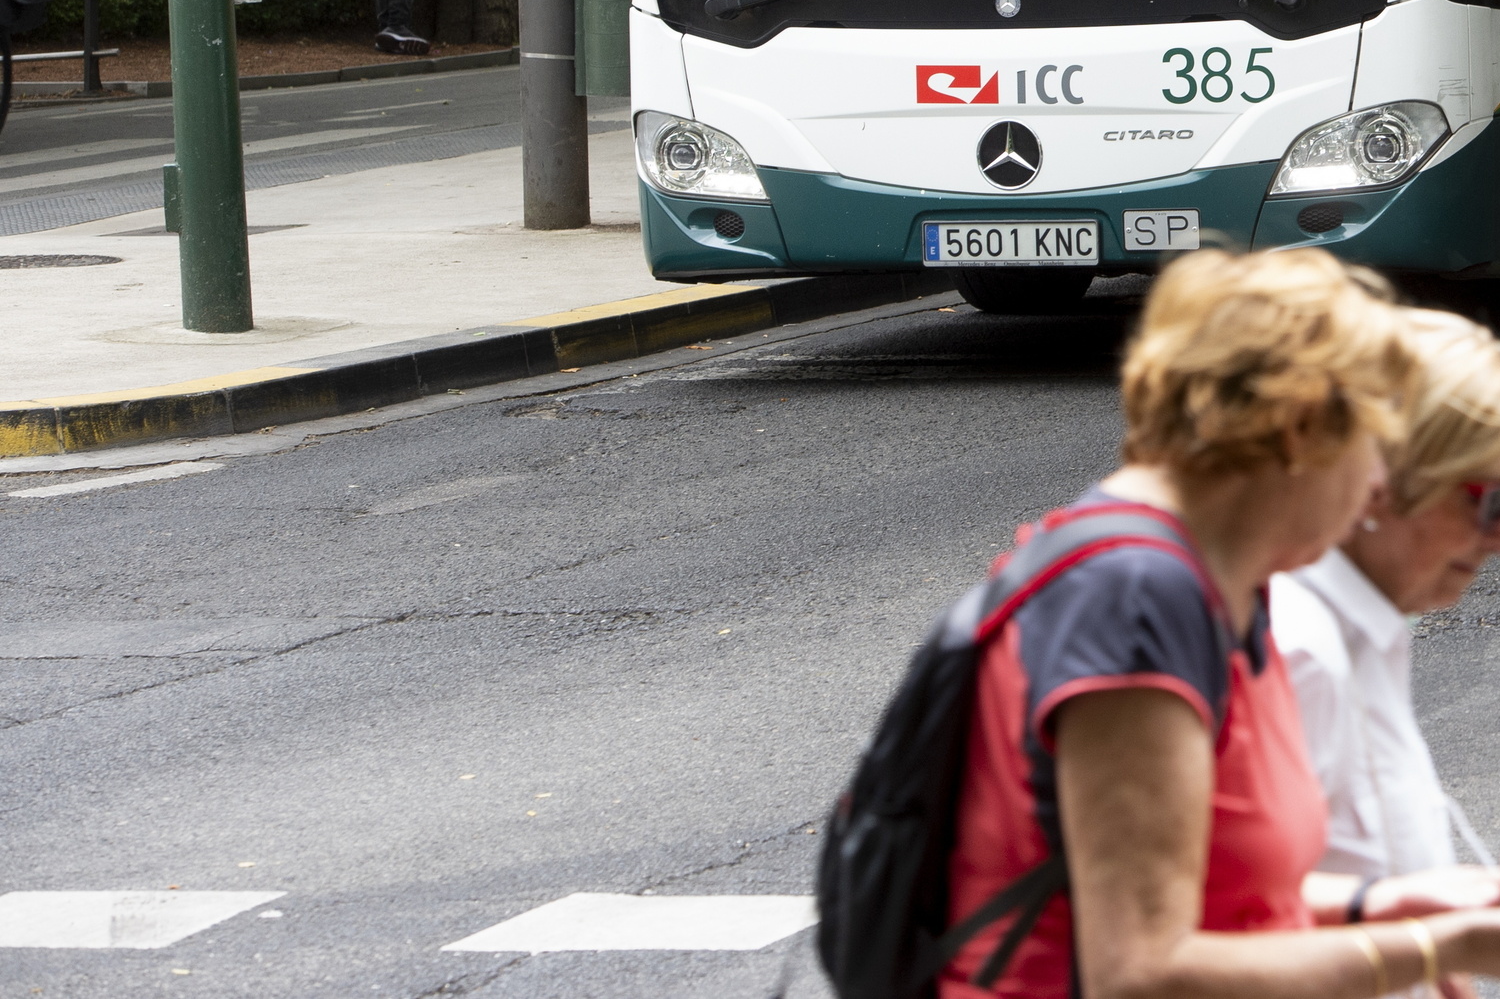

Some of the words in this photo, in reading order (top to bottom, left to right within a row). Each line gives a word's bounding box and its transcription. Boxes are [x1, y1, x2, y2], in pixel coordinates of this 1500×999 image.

[1016, 64, 1084, 105] ICC
[1161, 46, 1275, 105] 385
[1103, 129, 1194, 142] CITARO
[930, 246, 936, 255] E
[946, 228, 1019, 258] 5601
[1035, 227, 1093, 257] KNC
